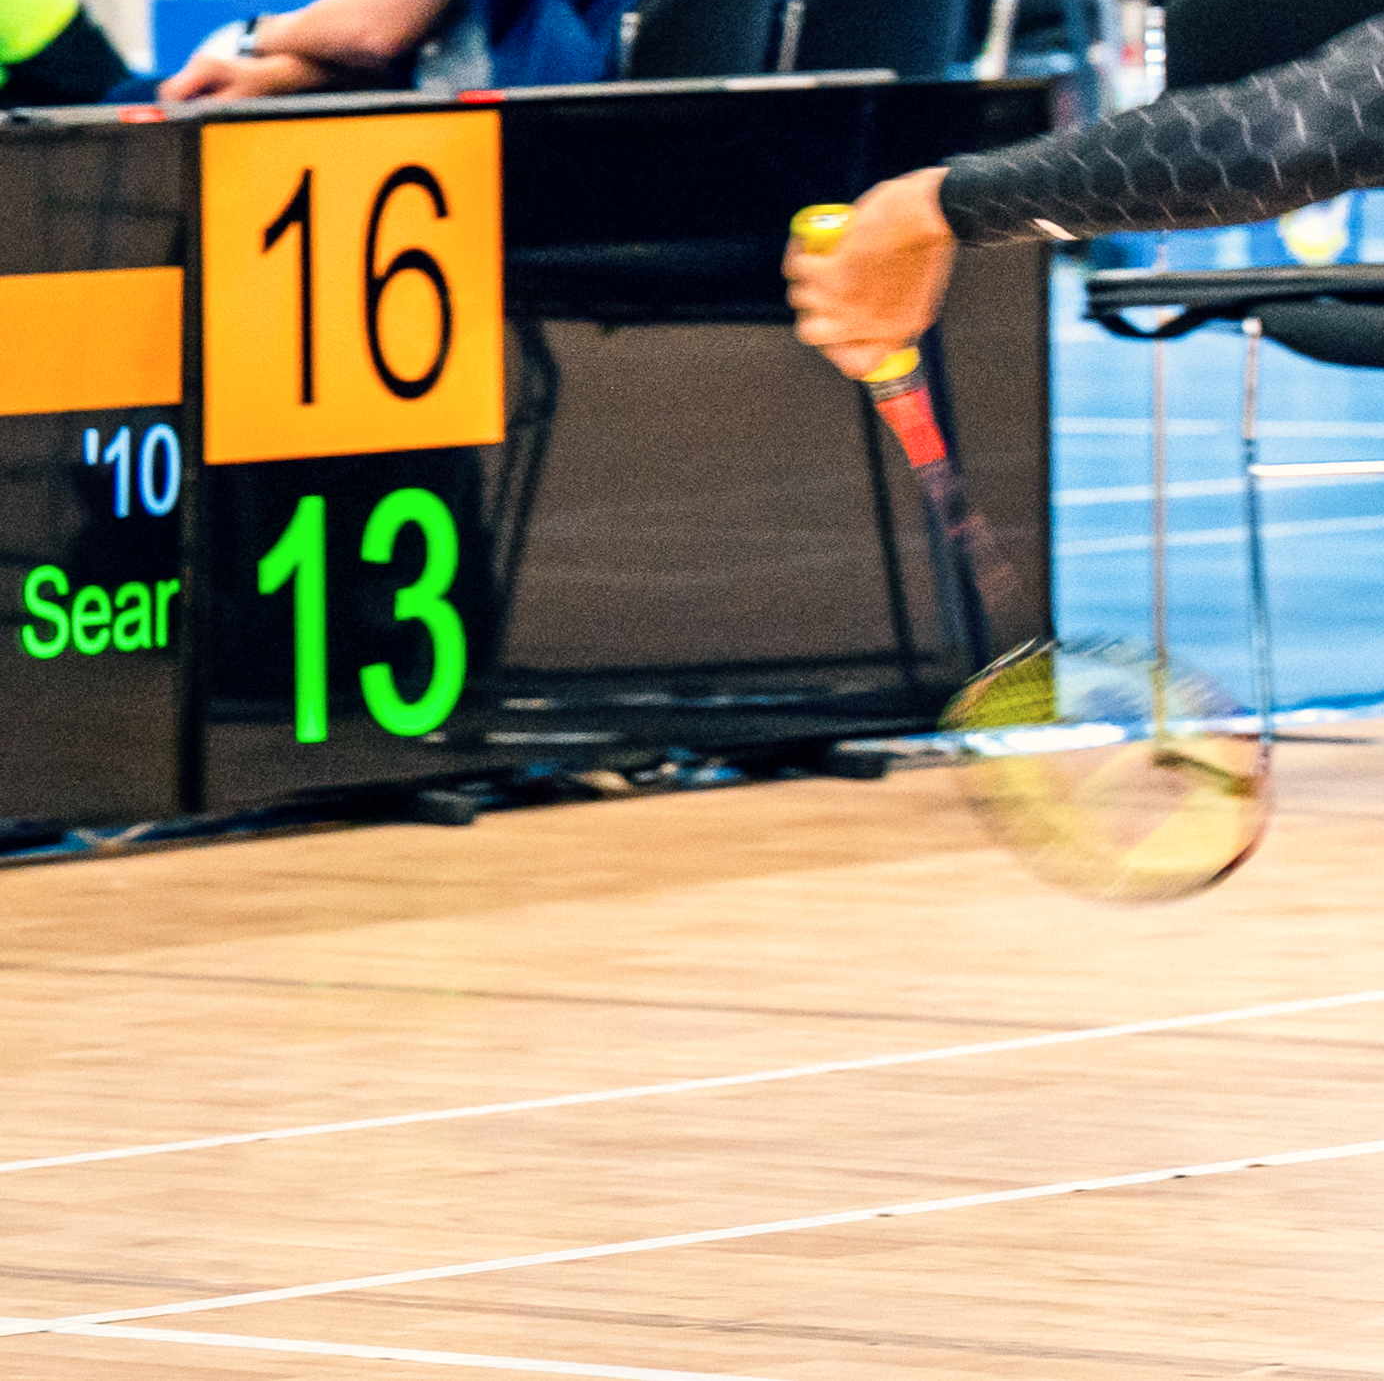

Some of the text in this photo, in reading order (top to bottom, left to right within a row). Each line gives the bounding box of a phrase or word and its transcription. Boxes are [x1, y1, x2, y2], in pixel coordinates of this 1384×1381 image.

[264, 164, 453, 406] 16
[21, 564, 181, 660] Sear
[257, 487, 467, 744] 13
